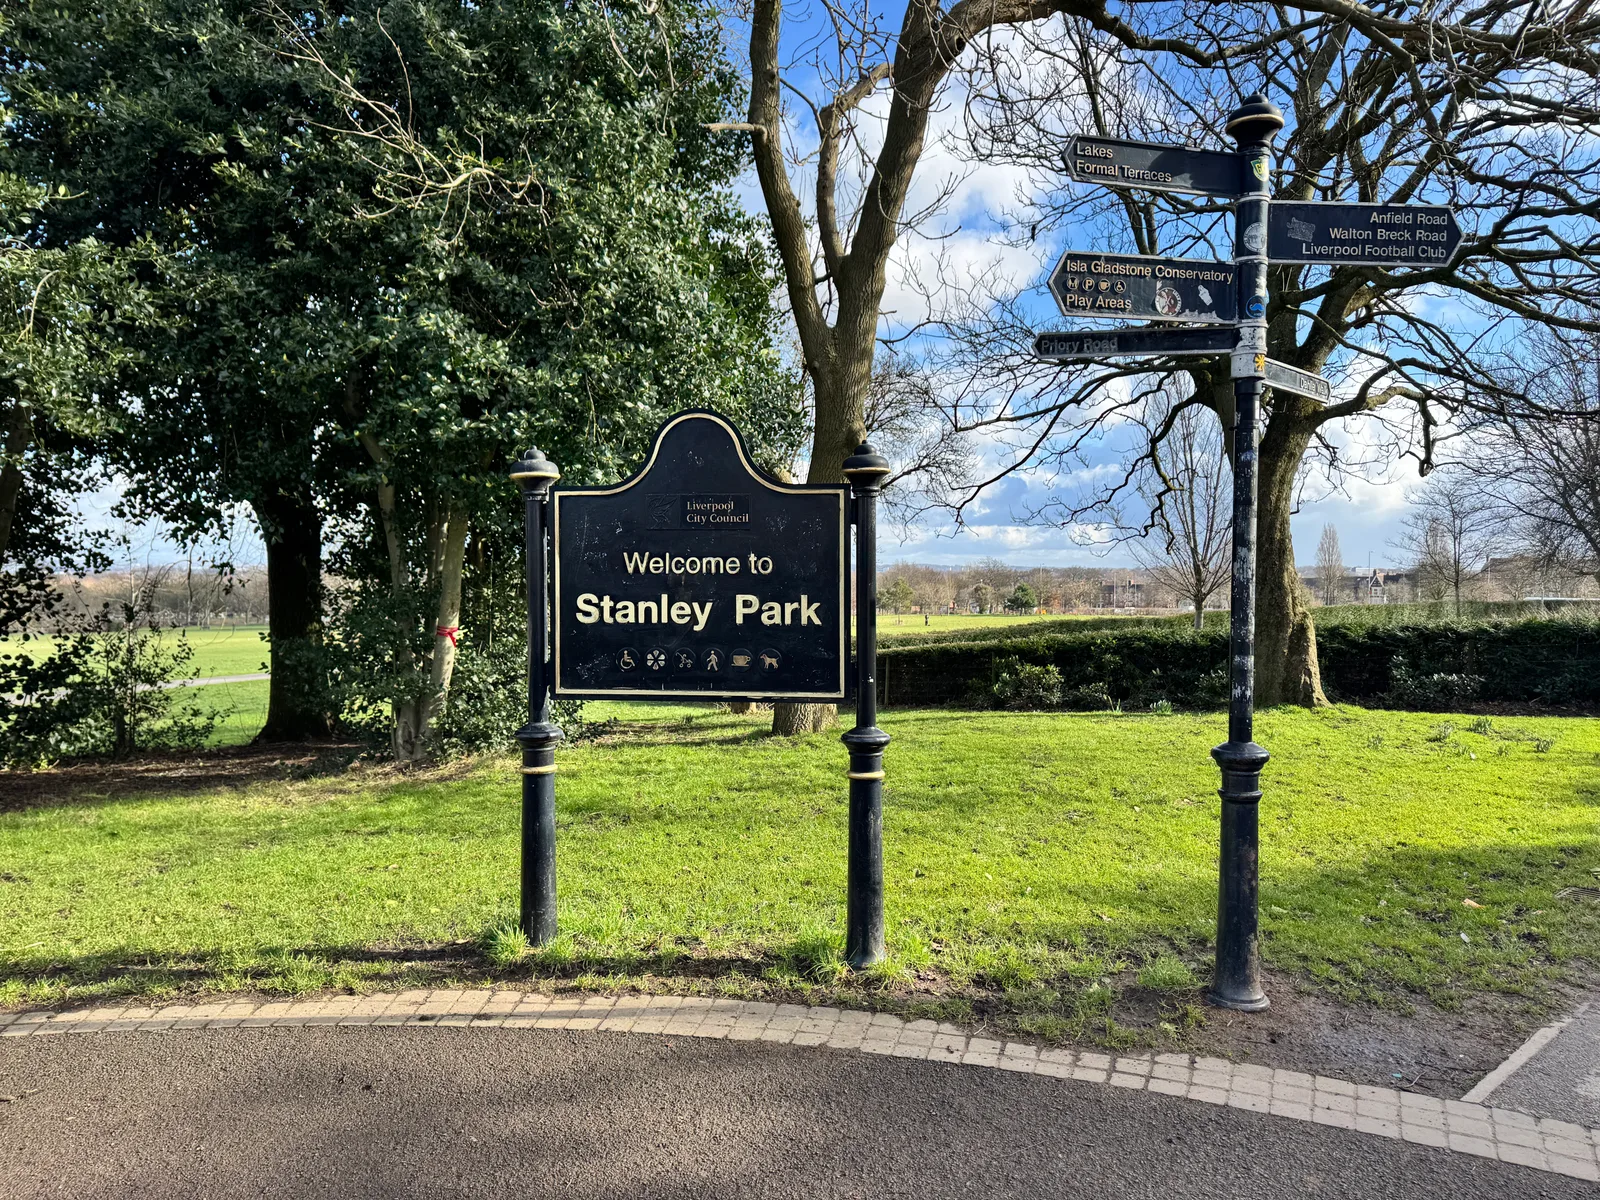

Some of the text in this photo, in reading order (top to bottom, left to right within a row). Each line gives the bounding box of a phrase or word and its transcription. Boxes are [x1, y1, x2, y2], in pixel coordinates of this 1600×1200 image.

[1076, 142, 1113, 158] Lakes
[1076, 160, 1172, 182] Formal Terraces
[1370, 212, 1448, 225] Anfield Road
[1329, 228, 1372, 240] Walton
[1377, 228, 1411, 241] Breck
[1416, 229, 1447, 242] Road
[1302, 243, 1446, 260] Liverpool Football Club
[1066, 260, 1233, 284] Isla Gladstone Conservatory
[1066, 294, 1132, 309] Play Areas
[1041, 338, 1118, 353] Priory Road
[687, 501, 734, 512] Liverpool
[686, 513, 749, 525] City Council
[623, 551, 773, 575] Welcome to
[576, 593, 822, 631] Stanley Park
